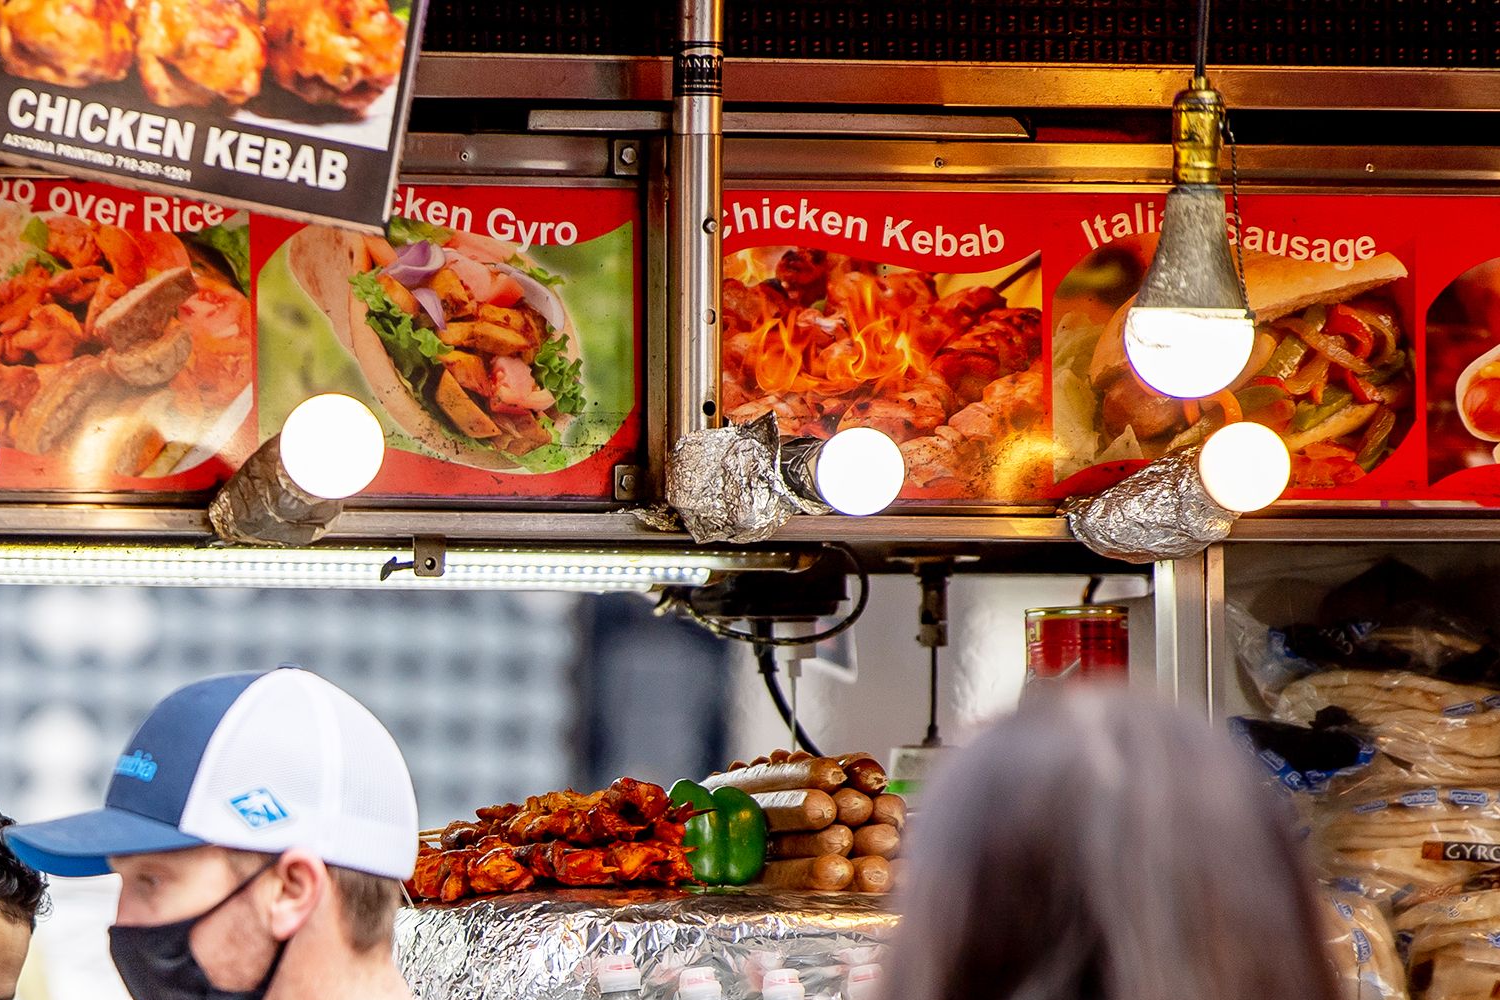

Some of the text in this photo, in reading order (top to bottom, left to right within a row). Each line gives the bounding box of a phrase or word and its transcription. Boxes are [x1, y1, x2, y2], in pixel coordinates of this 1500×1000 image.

[2, 132, 55, 155] ASTORIA
[56, 143, 115, 167] PRINTING
[7, 88, 196, 162] CHICKEN
[203, 126, 349, 191] KEBAB
[49, 186, 134, 228] over
[144, 197, 224, 232] Rice
[392, 187, 578, 253] cken Gyro
[882, 216, 1005, 257] Kebab
[1081, 202, 1376, 271] Itali Sausage
